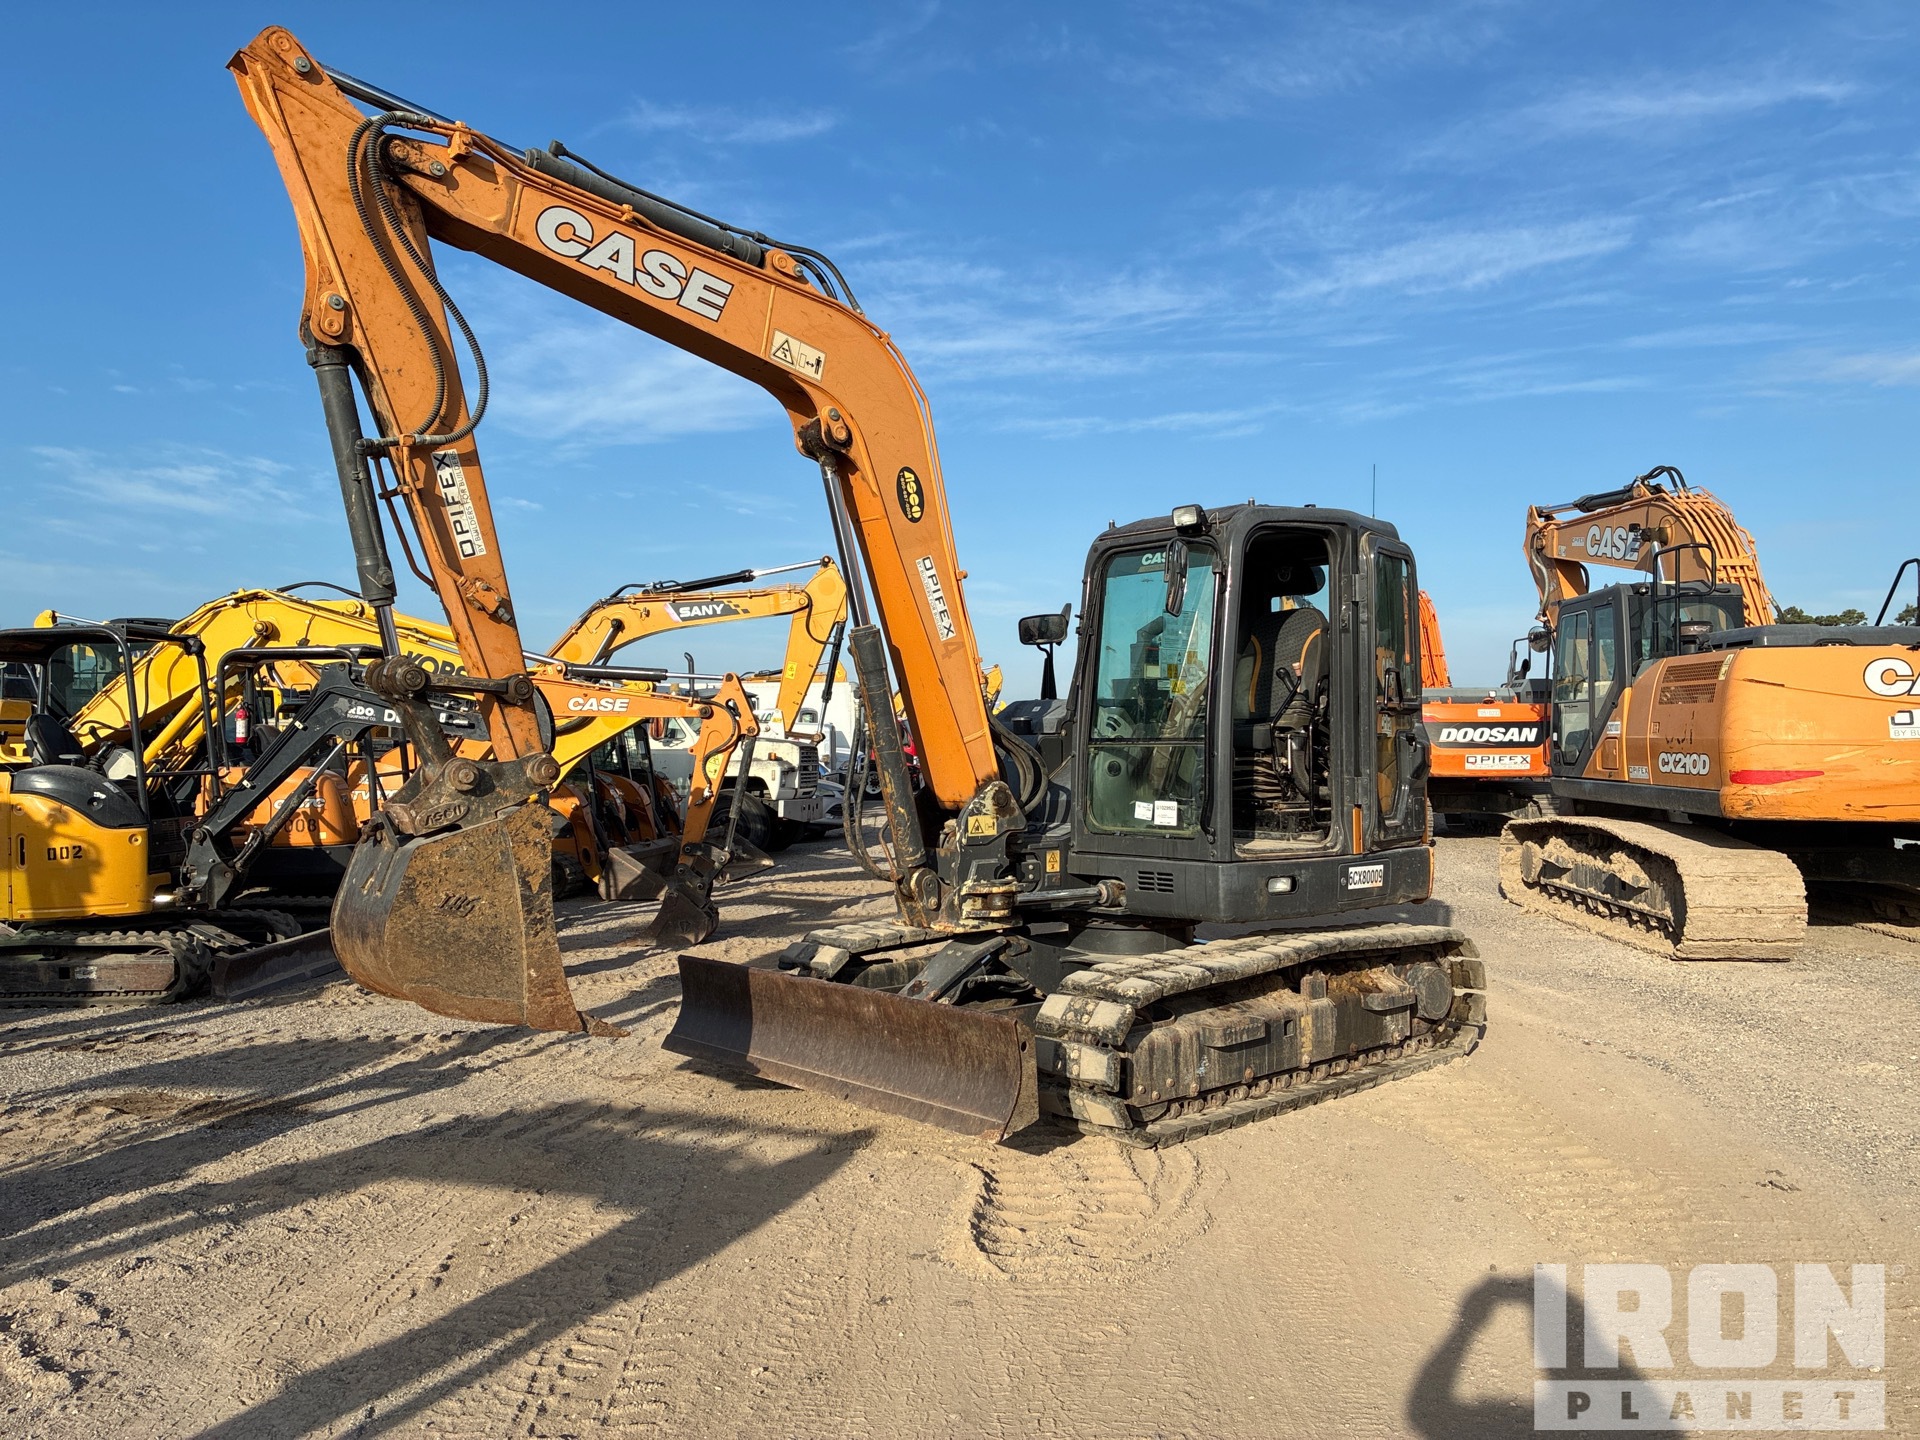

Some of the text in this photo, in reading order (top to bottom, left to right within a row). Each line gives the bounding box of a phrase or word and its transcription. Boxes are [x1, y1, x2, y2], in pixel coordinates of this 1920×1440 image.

[535, 205, 735, 322] CASE
[432, 452, 476, 559] OPIFEX
[449, 450, 485, 553] BY BUILDERS FOR BUILDERS
[903, 470, 922, 518] ASCO
[1586, 524, 1640, 562] CASE
[1141, 552, 1172, 566] CAS
[922, 556, 955, 637] OPIFEX
[679, 604, 725, 618] SANY
[1862, 657, 1920, 697] C
[567, 697, 630, 712] CASE
[1438, 727, 1538, 742] DOOSAN
[1658, 751, 1710, 775] CX210D
[284, 818, 317, 832] 008
[47, 845, 83, 861] 002
[1348, 868, 1383, 886] 6CX80009
